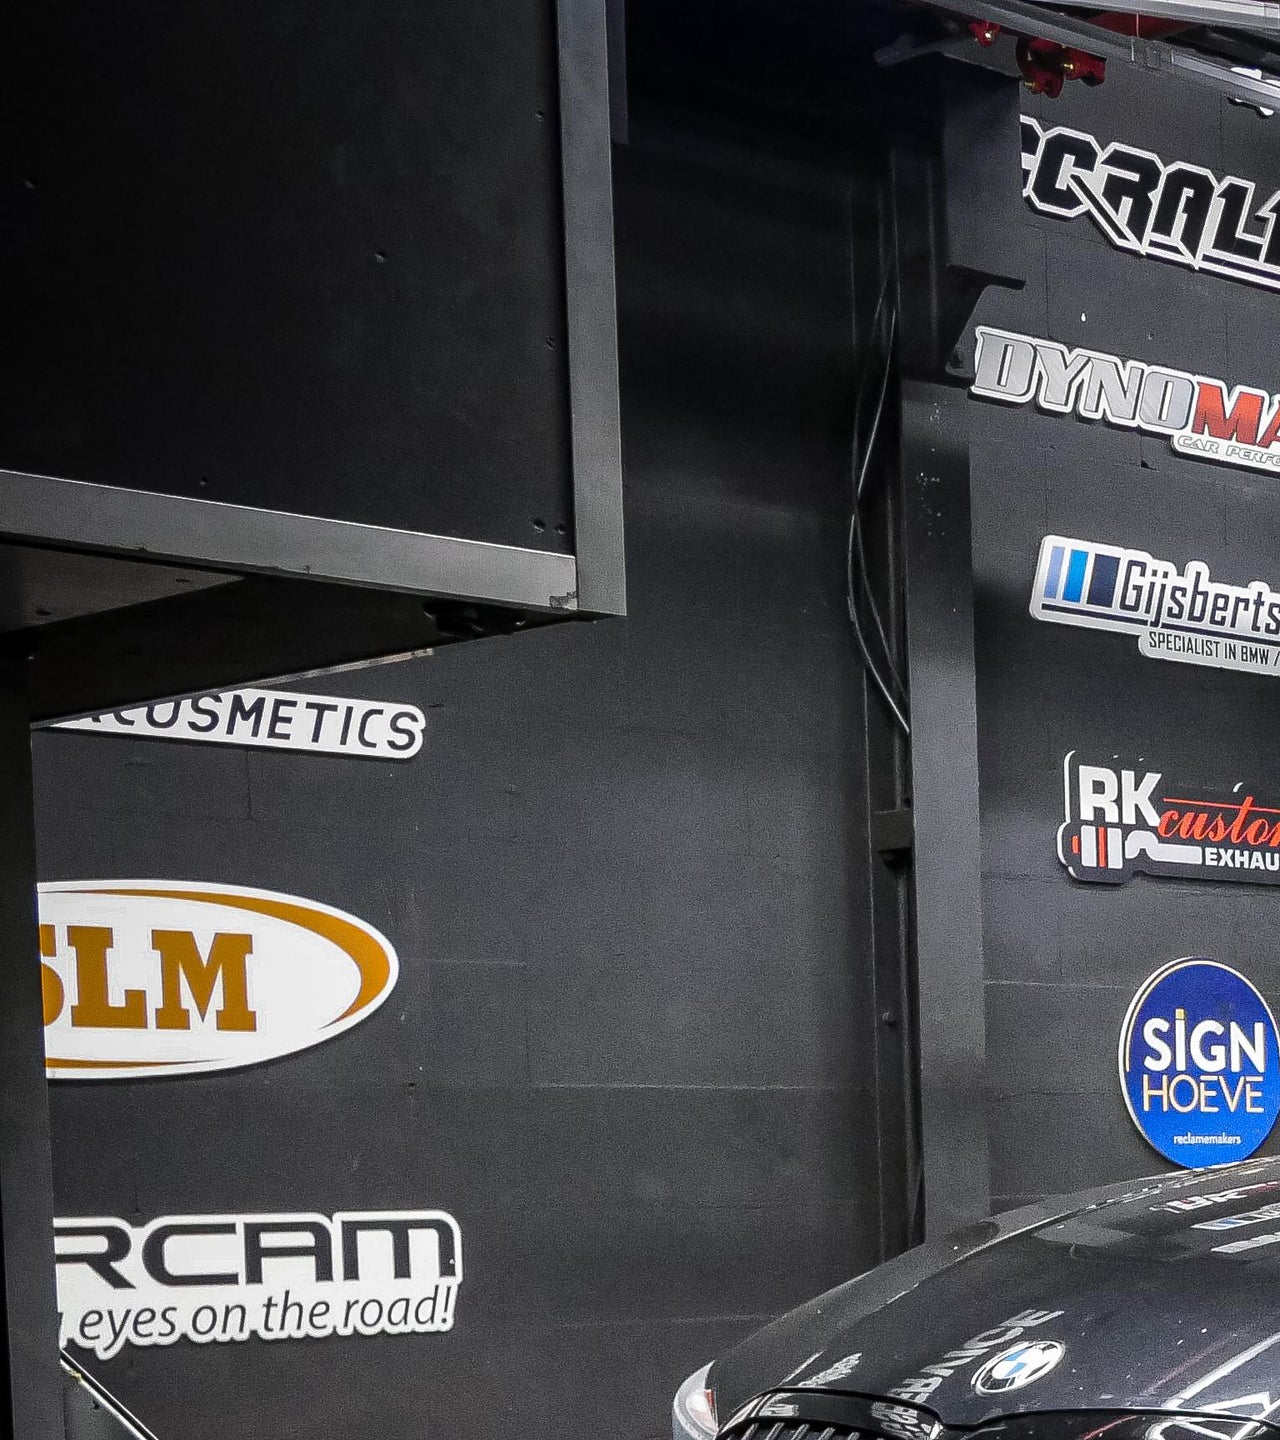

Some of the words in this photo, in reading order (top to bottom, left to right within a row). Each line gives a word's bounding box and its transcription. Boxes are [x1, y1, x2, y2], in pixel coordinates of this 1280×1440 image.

[1177, 434, 1219, 454] CAR
[1148, 630, 1221, 658] SPECIALIST
[1224, 643, 1237, 661] IN
[1240, 645, 1270, 666] BMW
[91, 694, 422, 750] OSMETICS
[1078, 764, 1163, 827] RK
[1143, 1074, 1265, 1113] HOEVE
[1172, 1135, 1242, 1146] reclamemakers
[79, 1306, 176, 1352] eyes
[191, 1301, 247, 1336] on
[262, 1289, 330, 1332] the
[343, 1285, 453, 1329] road!
